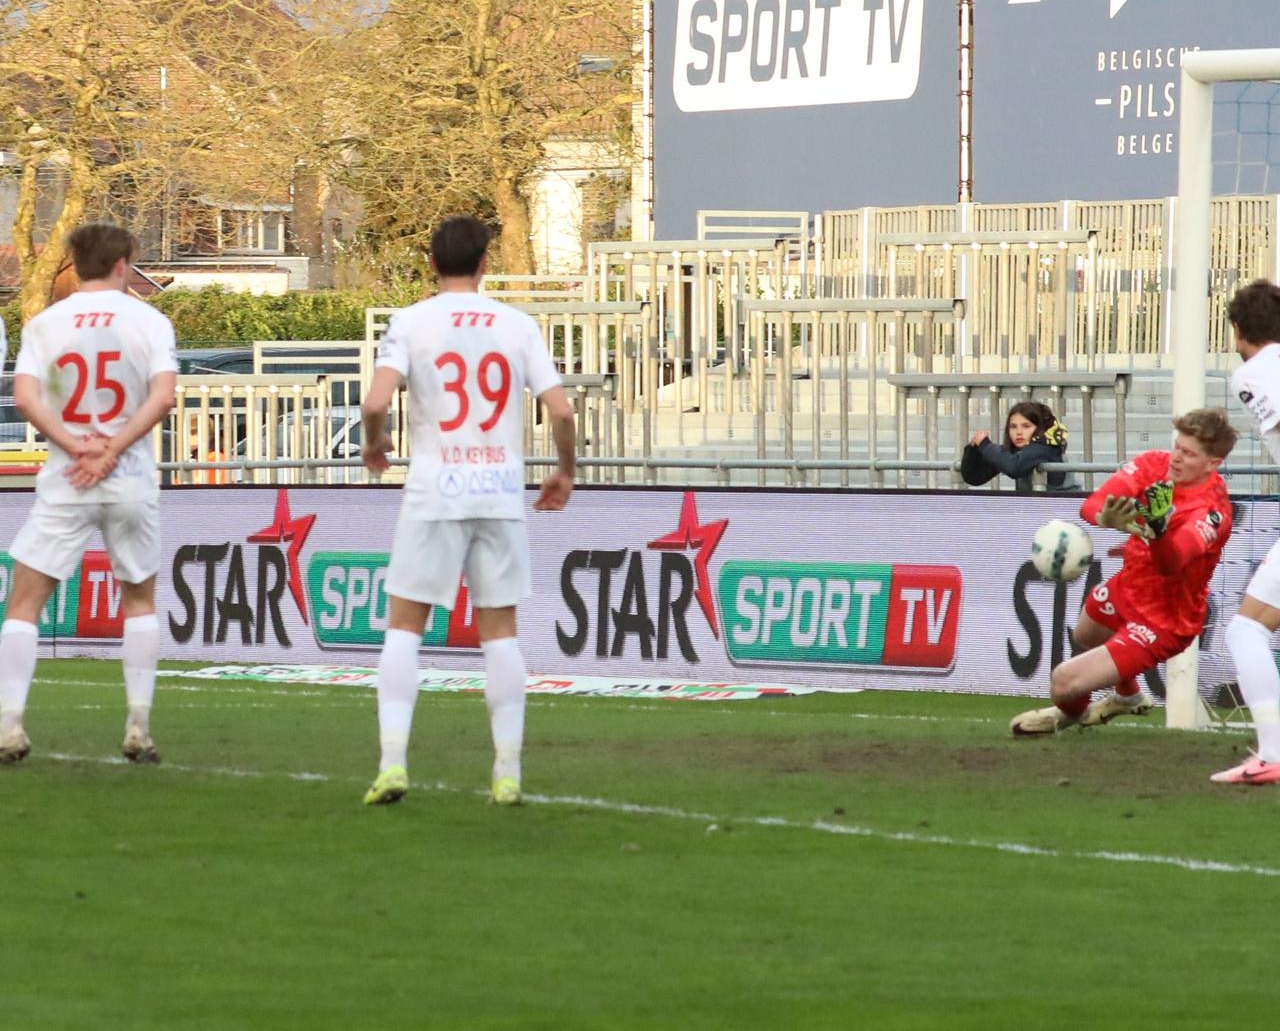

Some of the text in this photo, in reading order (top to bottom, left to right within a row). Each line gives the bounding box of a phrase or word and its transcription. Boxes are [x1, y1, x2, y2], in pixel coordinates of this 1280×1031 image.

[1097, 46, 1200, 71] BELGISC
[1117, 133, 1173, 155] BELGE
[73, 312, 116, 329] 777
[451, 311, 497, 327] 777
[55, 350, 126, 424] 25
[434, 350, 512, 433] 39
[464, 445, 507, 464] KEYBUS
[87, 572, 122, 619] TV
[168, 541, 293, 648] STAR
[319, 565, 389, 630] SPO
[555, 547, 700, 663] STAR
[731, 571, 885, 650] SPORT
[900, 588, 952, 646] TV
